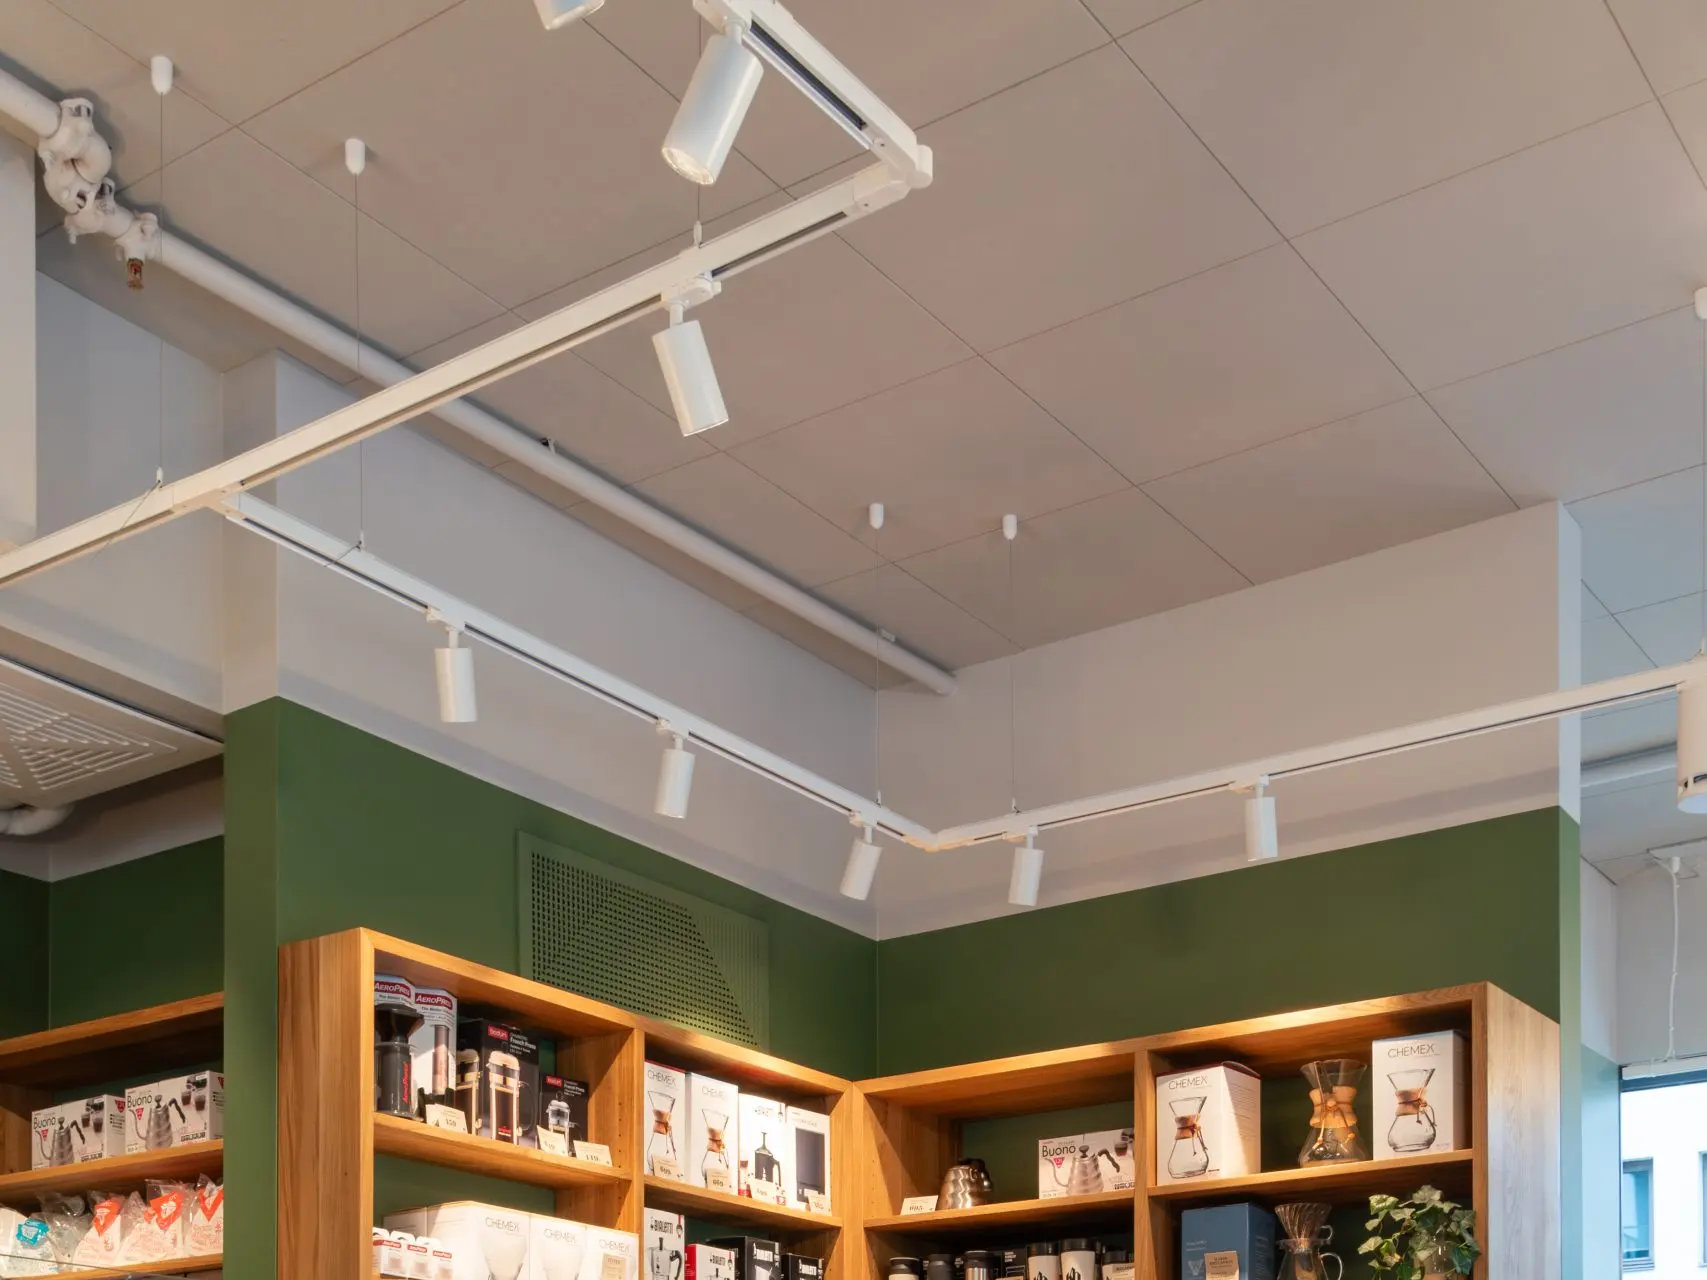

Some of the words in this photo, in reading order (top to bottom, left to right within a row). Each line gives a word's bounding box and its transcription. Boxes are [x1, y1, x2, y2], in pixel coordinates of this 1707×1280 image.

[1387, 1043, 1435, 1058] CHEMEX
[647, 1069, 677, 1086] CHEMEX
[1168, 1075, 1208, 1090] CHEMEX
[702, 1085, 727, 1098] CHEME
[127, 1094, 152, 1108] Buono
[33, 1116, 56, 1130] Buono
[1042, 1145, 1076, 1157] Buono
[485, 1217, 520, 1233] CHEMEX
[654, 1219, 674, 1235] BIALETTI
[543, 1228, 576, 1244] CHEMEX
[599, 1238, 631, 1254] CHEMEX
